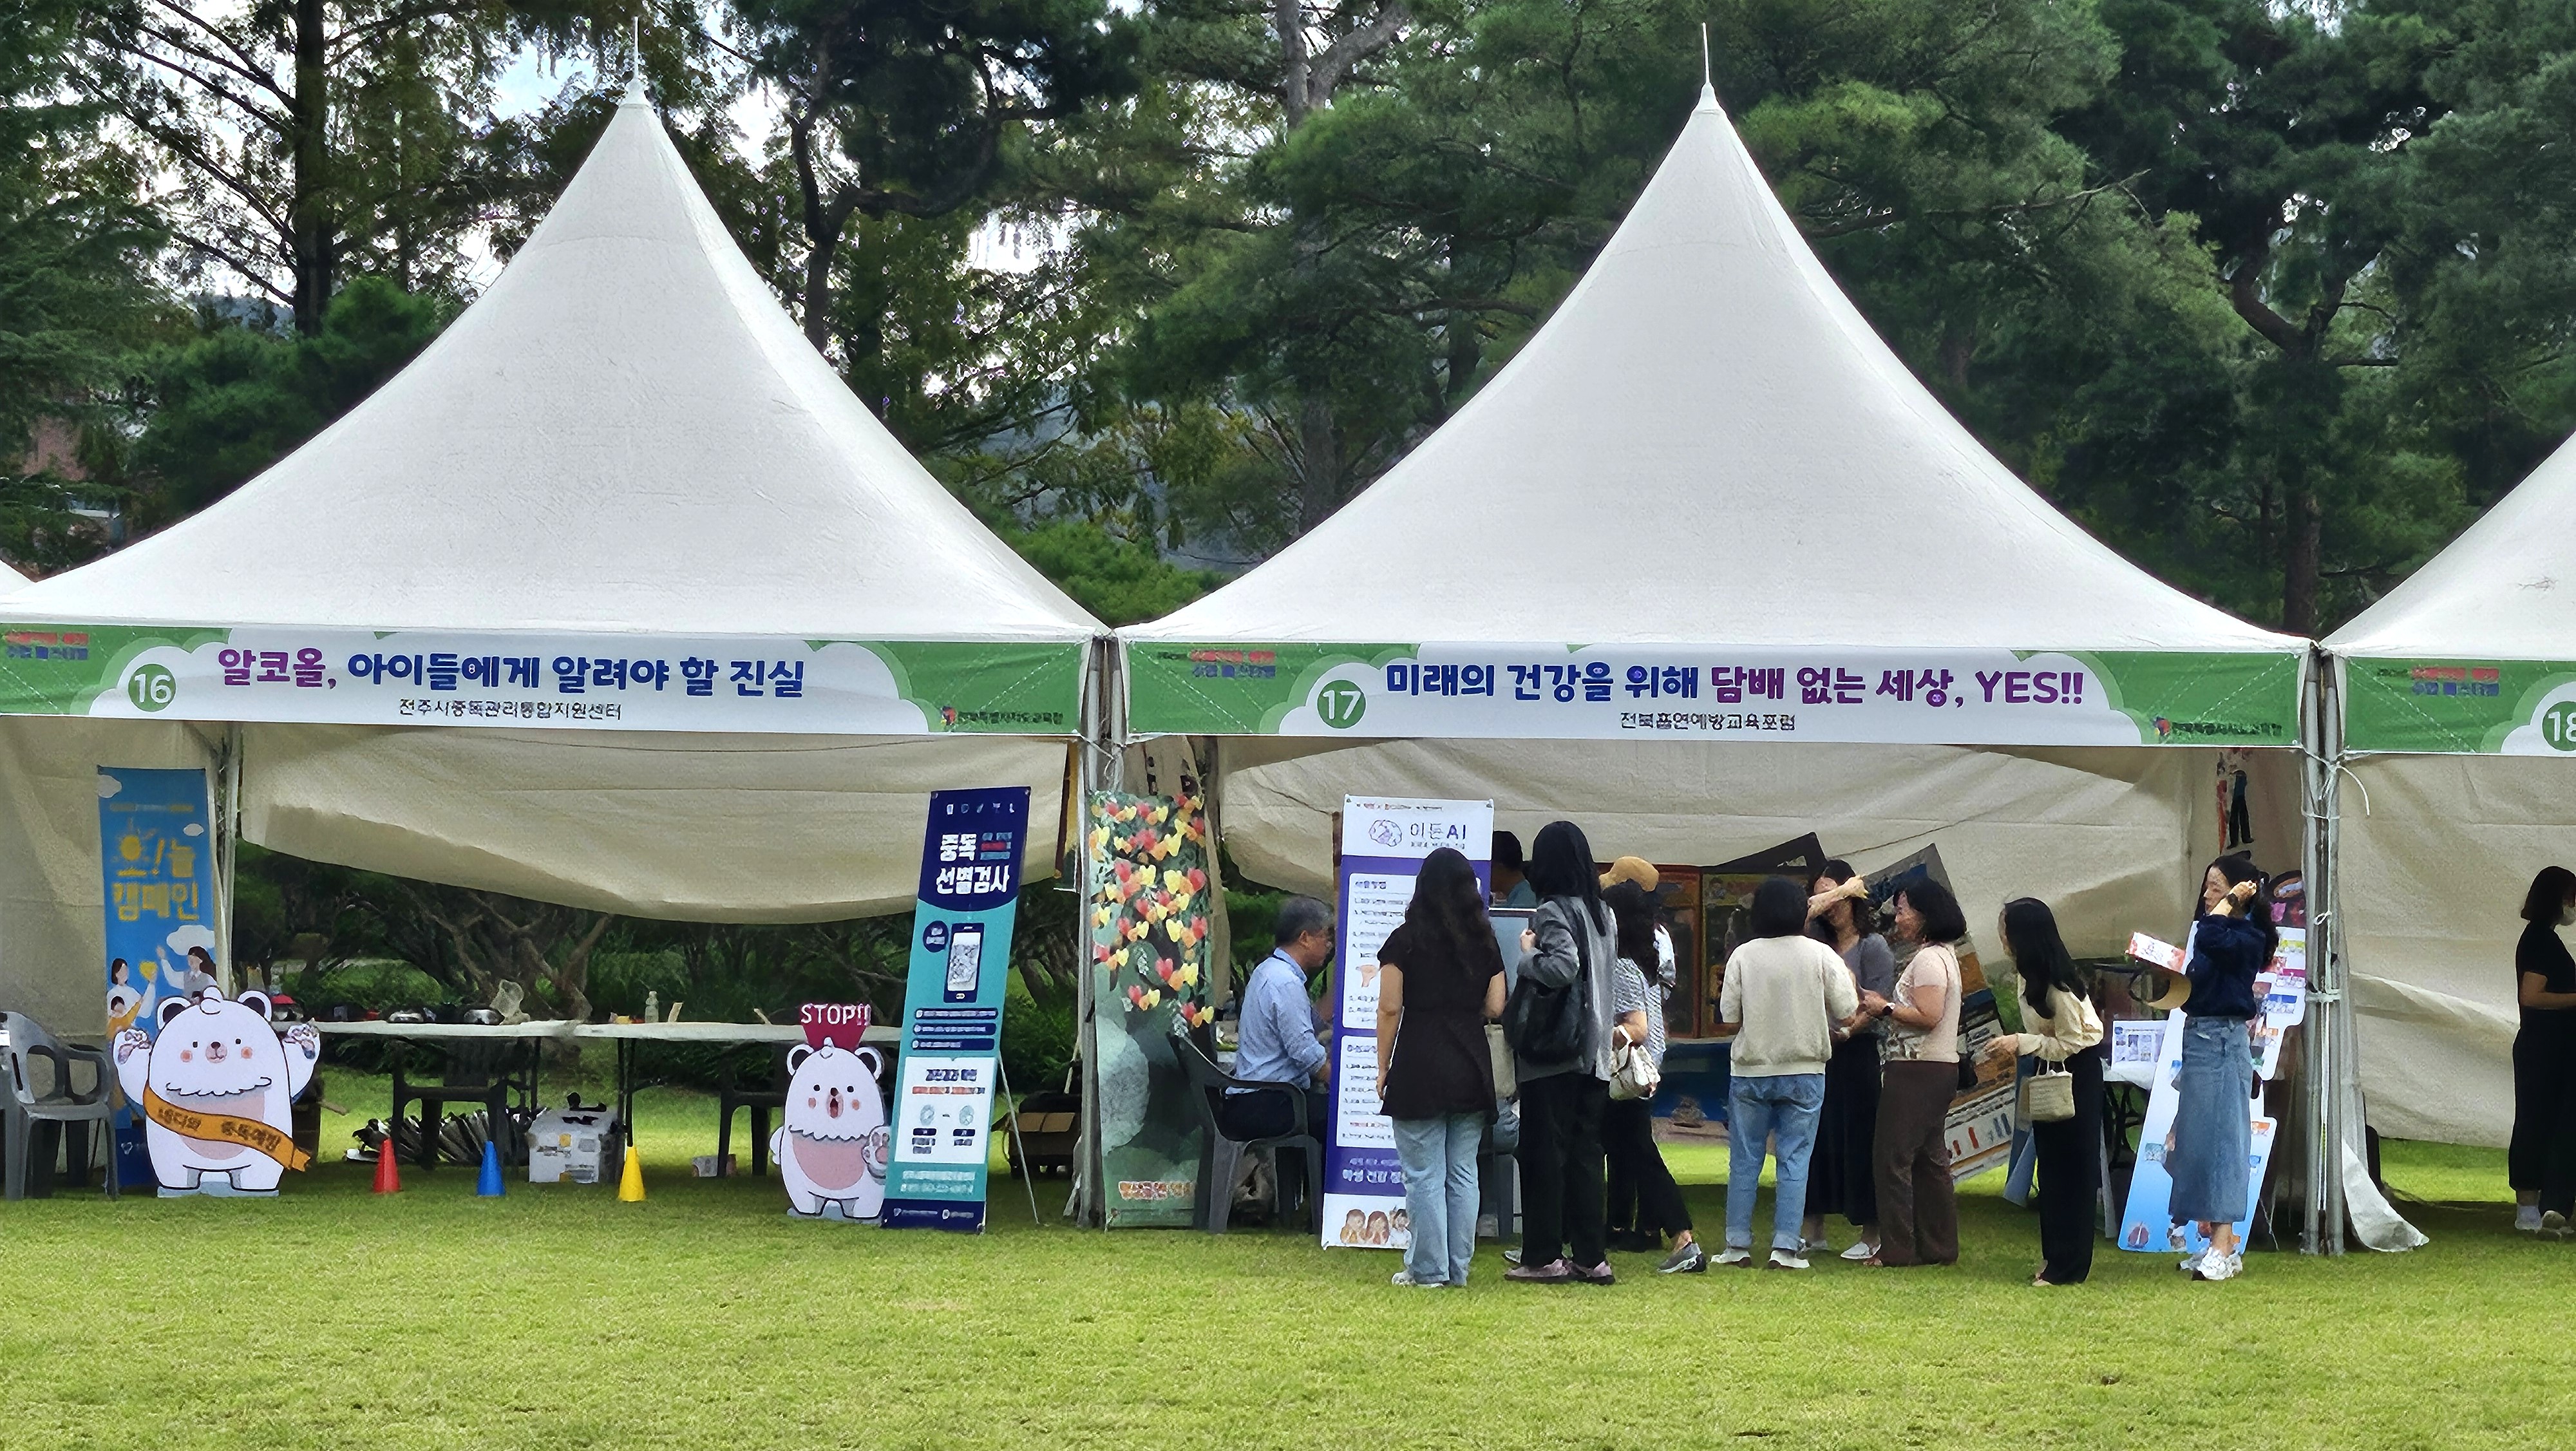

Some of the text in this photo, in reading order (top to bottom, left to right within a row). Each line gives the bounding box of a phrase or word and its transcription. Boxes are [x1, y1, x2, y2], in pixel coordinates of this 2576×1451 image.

[218, 647, 805, 698] 알코올, 아이들에게 알려야 할 진실
[1387, 662, 2084, 708] 미래의 건강을 위해 담배 없는 세상, YES!!
[134, 673, 171, 705] 16
[1321, 688, 1360, 719] 17
[940, 833, 977, 862] 중독
[936, 865, 1010, 895] 선별검사
[800, 1003, 871, 1026] STOP!!
